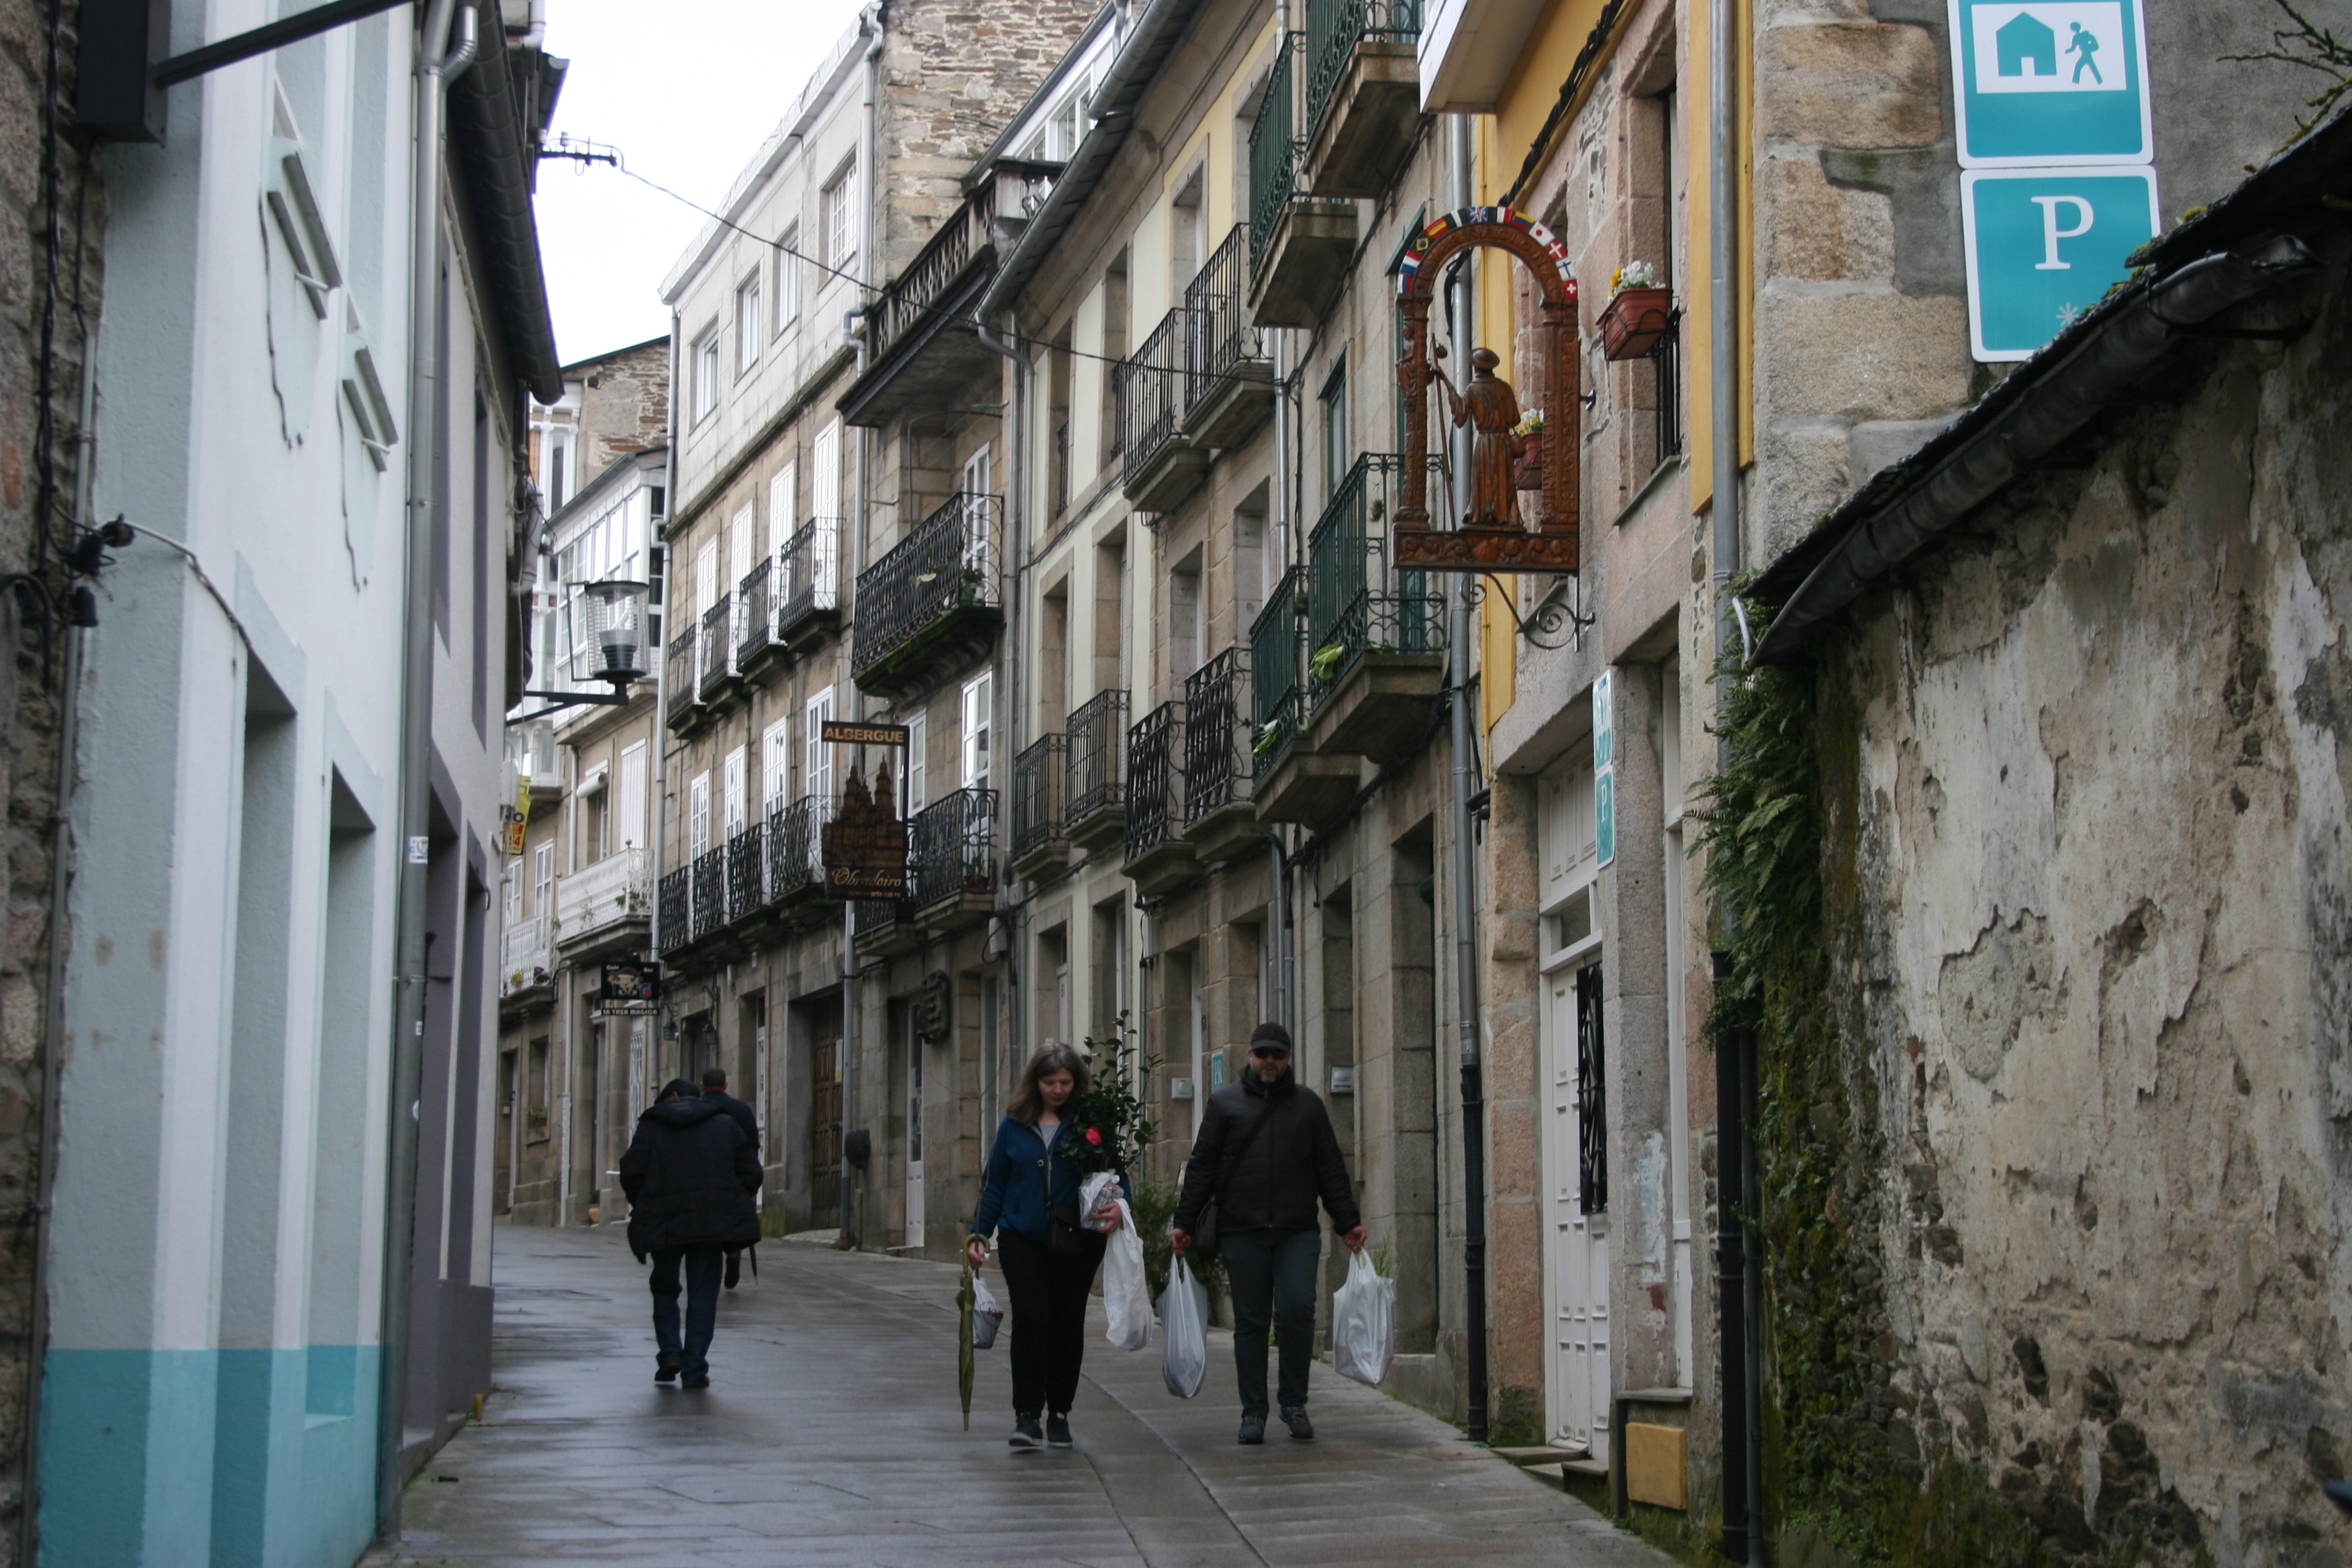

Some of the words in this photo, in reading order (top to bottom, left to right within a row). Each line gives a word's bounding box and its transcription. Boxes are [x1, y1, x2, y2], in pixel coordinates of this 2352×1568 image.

[2030, 196, 2094, 269] P
[824, 726, 904, 743] ALBERGUE
[832, 867, 902, 887] Obradoiro
